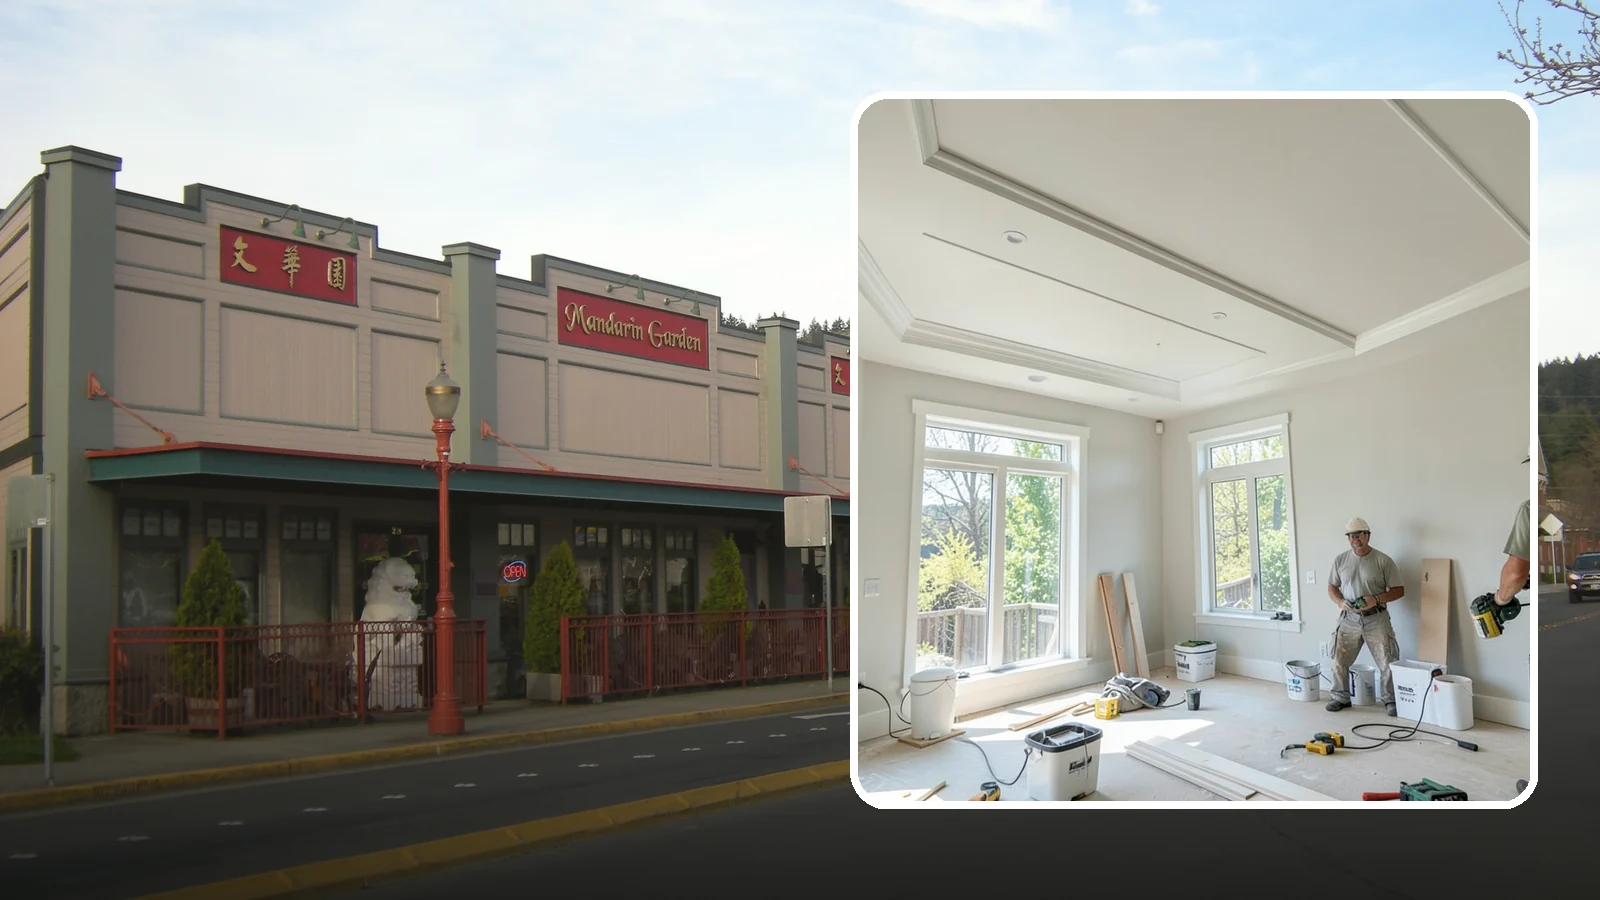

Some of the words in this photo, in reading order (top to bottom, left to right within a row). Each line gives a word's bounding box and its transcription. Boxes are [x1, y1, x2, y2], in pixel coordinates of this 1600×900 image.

[230, 235, 346, 291] 文華園
[564, 302, 644, 341] Mandarin
[648, 320, 701, 352] Garden
[503, 565, 527, 578] OPEN
